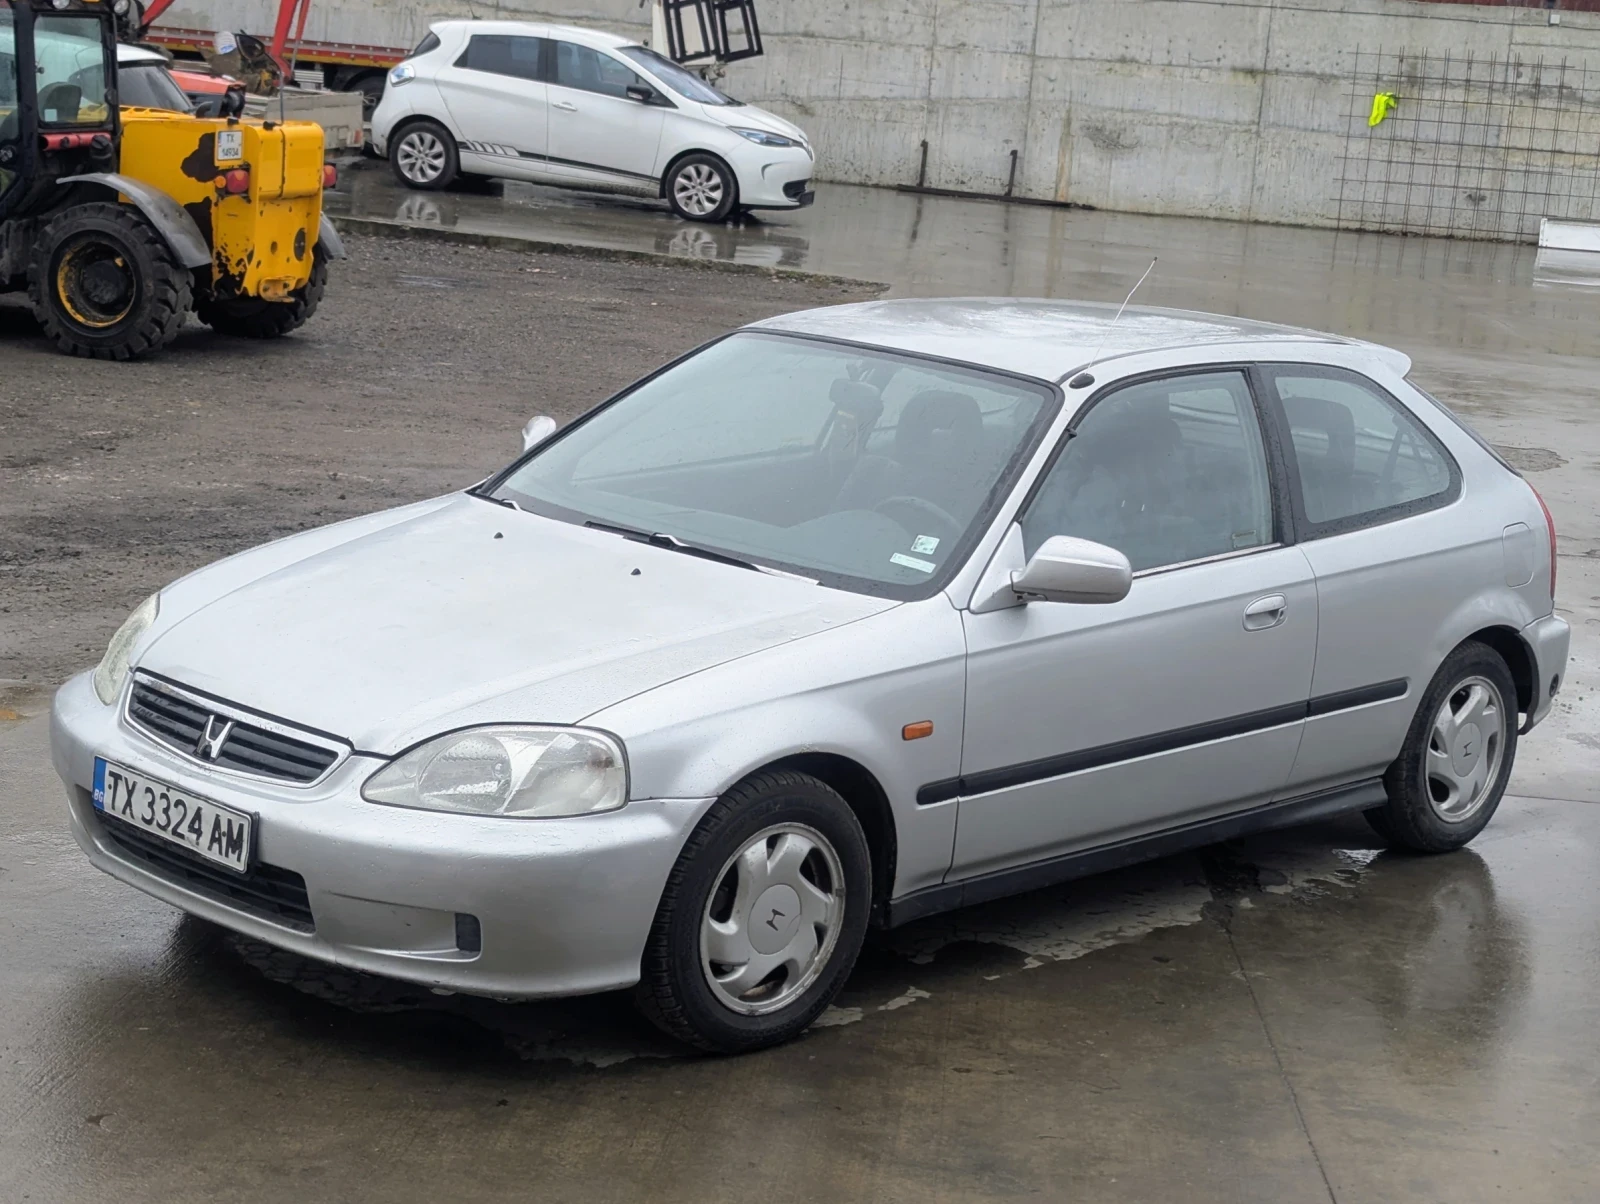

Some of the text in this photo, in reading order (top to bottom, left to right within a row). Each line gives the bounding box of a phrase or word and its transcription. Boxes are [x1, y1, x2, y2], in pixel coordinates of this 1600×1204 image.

[226, 133, 235, 143] TX
[93, 789, 104, 803] BG
[107, 769, 245, 863] TX 3324 AM
